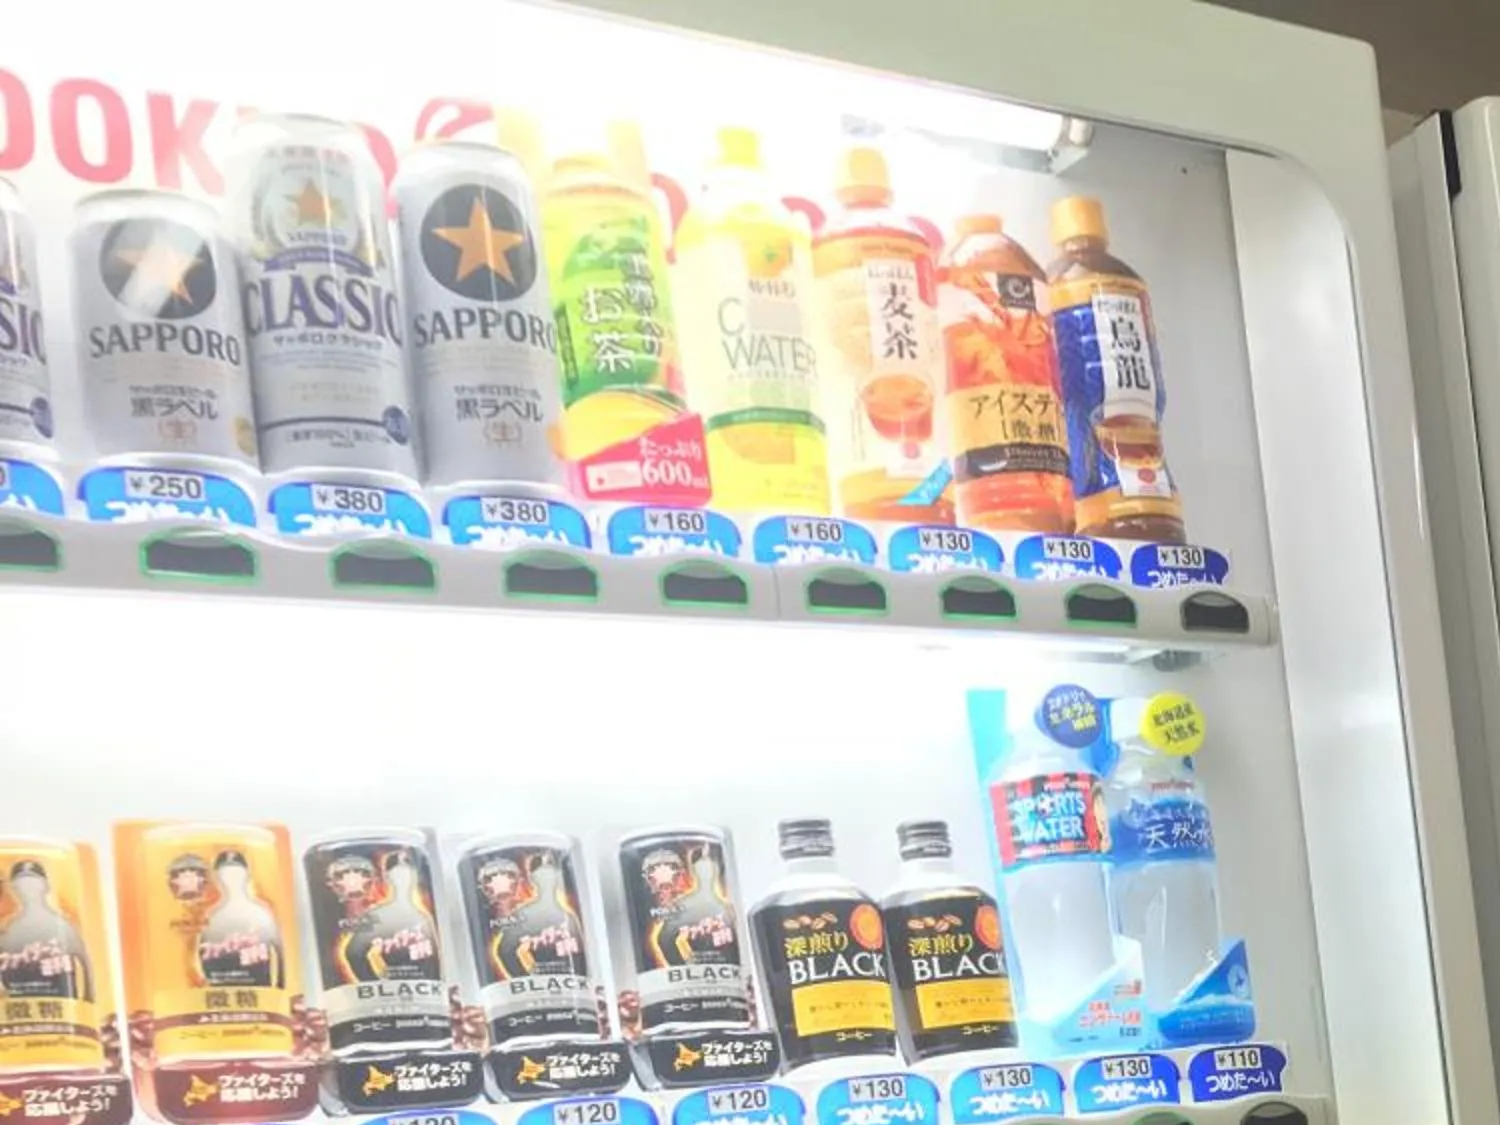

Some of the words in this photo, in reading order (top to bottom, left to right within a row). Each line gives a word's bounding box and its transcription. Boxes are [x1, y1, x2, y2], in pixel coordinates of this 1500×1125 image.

[413, 306, 558, 354] SAPPORO
[581, 285, 635, 374] お茶
[89, 322, 242, 367] SAPPORO
[129, 397, 219, 420] 黒ラベル
[455, 398, 544, 423] 黒ラベル
[129, 474, 202, 500] ¥250
[316, 487, 384, 513] ¥380
[485, 501, 547, 524] ¥380
[649, 512, 704, 532] ¥160
[790, 522, 842, 542] ¥160
[921, 532, 971, 551] ¥130
[1047, 541, 1092, 559] ¥130
[1160, 548, 1203, 566] ¥130
[1010, 791, 1087, 817] SPORTS
[1012, 815, 1086, 843] WATER
[667, 965, 743, 984] BLACK
[788, 951, 886, 985] BLACK
[357, 981, 443, 1001] BLACK
[510, 976, 590, 995] BLACK
[1104, 1058, 1150, 1078] ¥130
[1217, 1050, 1259, 1067] ¥110
[852, 1077, 903, 1098] ¥130
[984, 1068, 1031, 1087] ¥130
[712, 1089, 767, 1111] ¥120
[557, 1101, 617, 1125] ¥120
